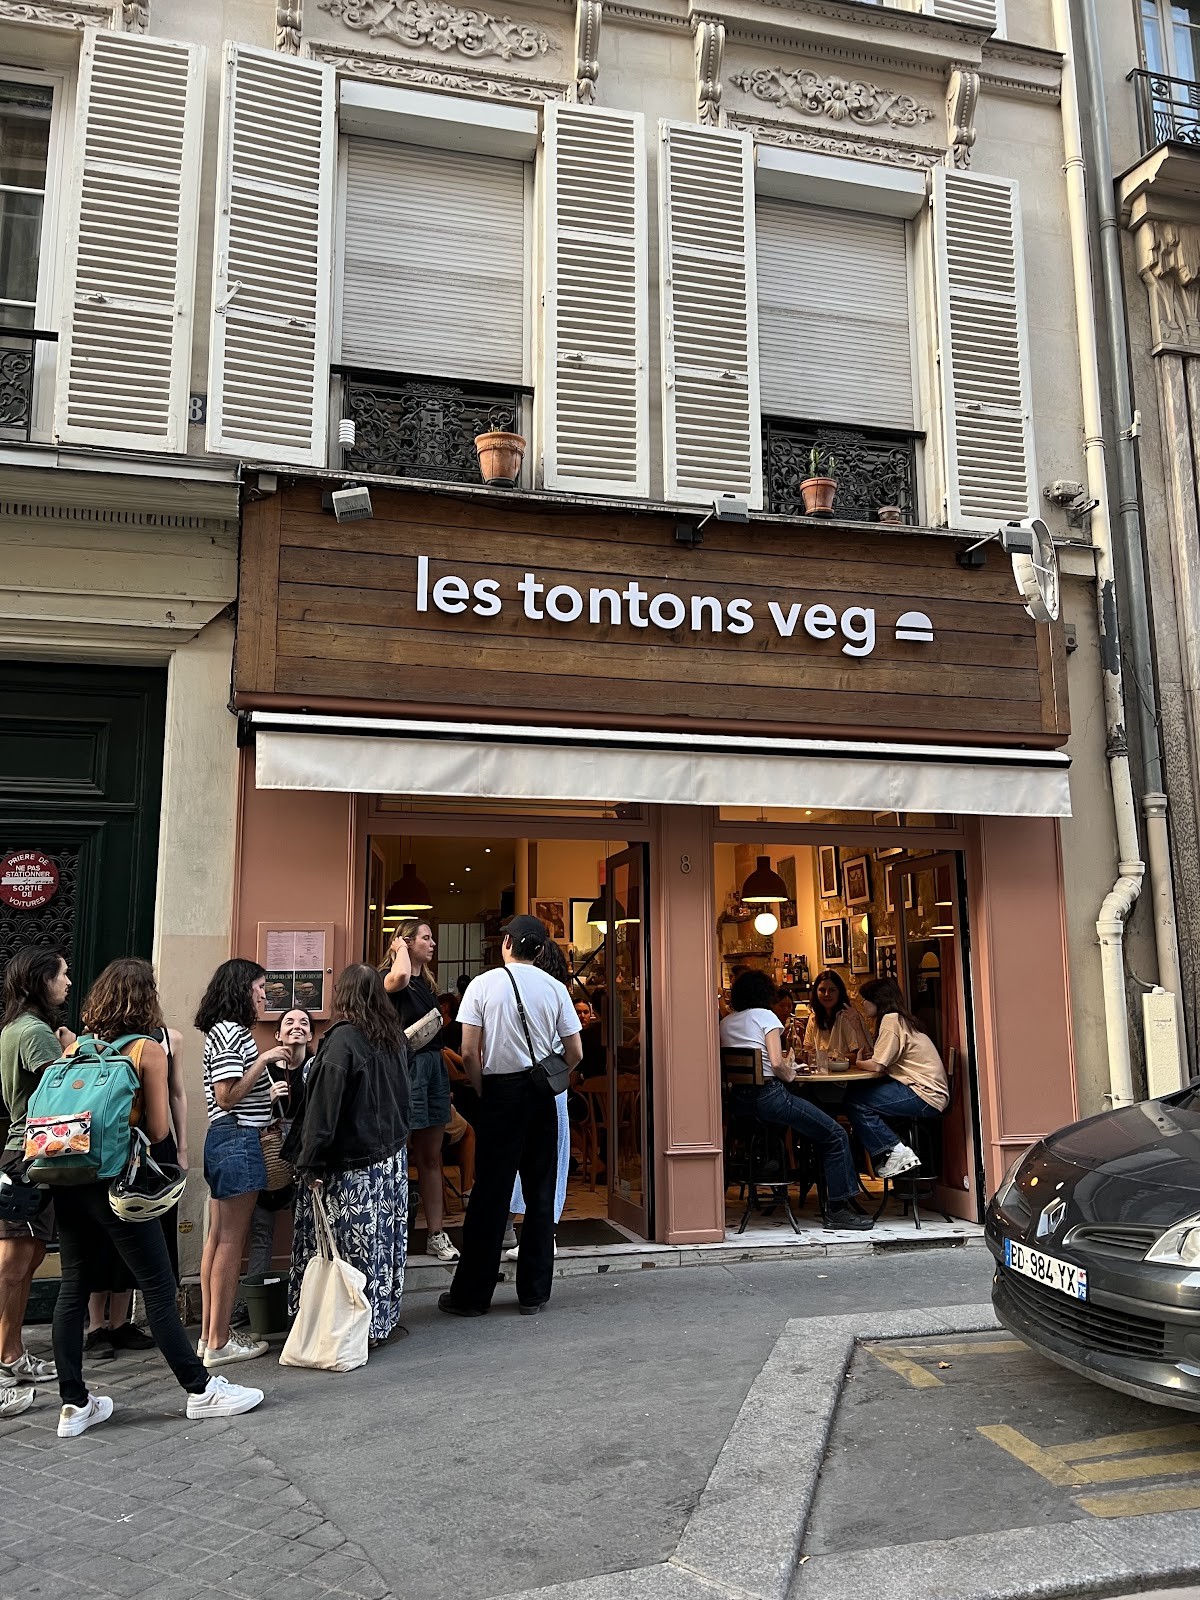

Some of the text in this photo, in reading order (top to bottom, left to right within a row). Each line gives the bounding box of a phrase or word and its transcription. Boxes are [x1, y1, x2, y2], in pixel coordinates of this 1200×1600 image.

[189, 397, 203, 421] 8
[416, 555, 876, 658] les tontons veg
[8, 853, 49, 866] PRIERE DE
[681, 854, 691, 874] 8
[12, 884, 43, 892] SORTIE
[9, 896, 46, 907] VOITURES
